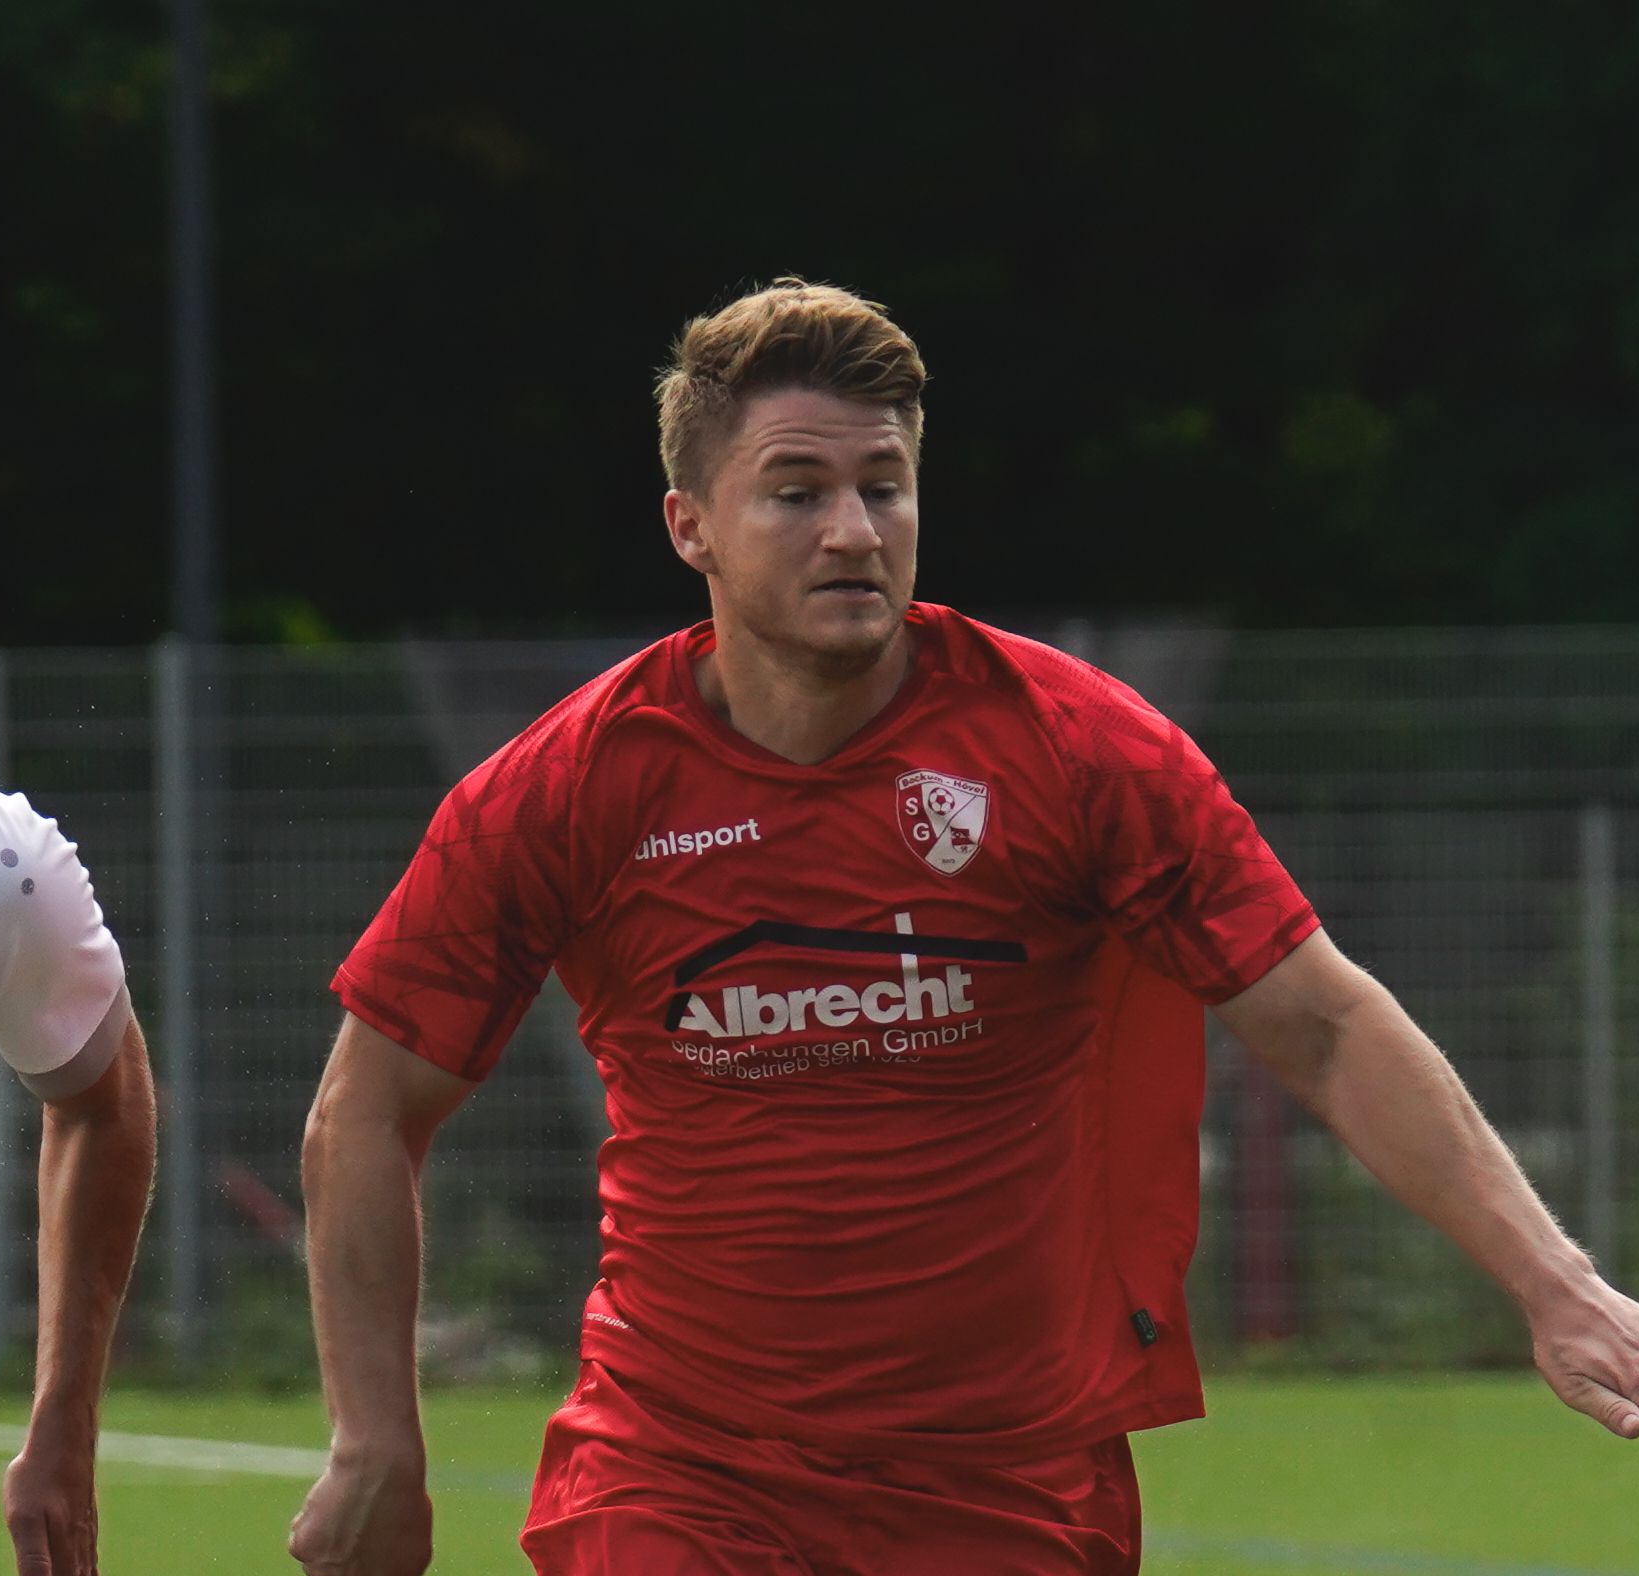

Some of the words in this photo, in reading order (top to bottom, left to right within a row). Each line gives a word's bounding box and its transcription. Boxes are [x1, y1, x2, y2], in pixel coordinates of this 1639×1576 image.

[905, 797, 919, 816] S
[635, 818, 761, 860] uhlsport
[912, 822, 930, 841] G
[678, 953, 976, 1038] Albrecht
[883, 1017, 984, 1054] GmbH
